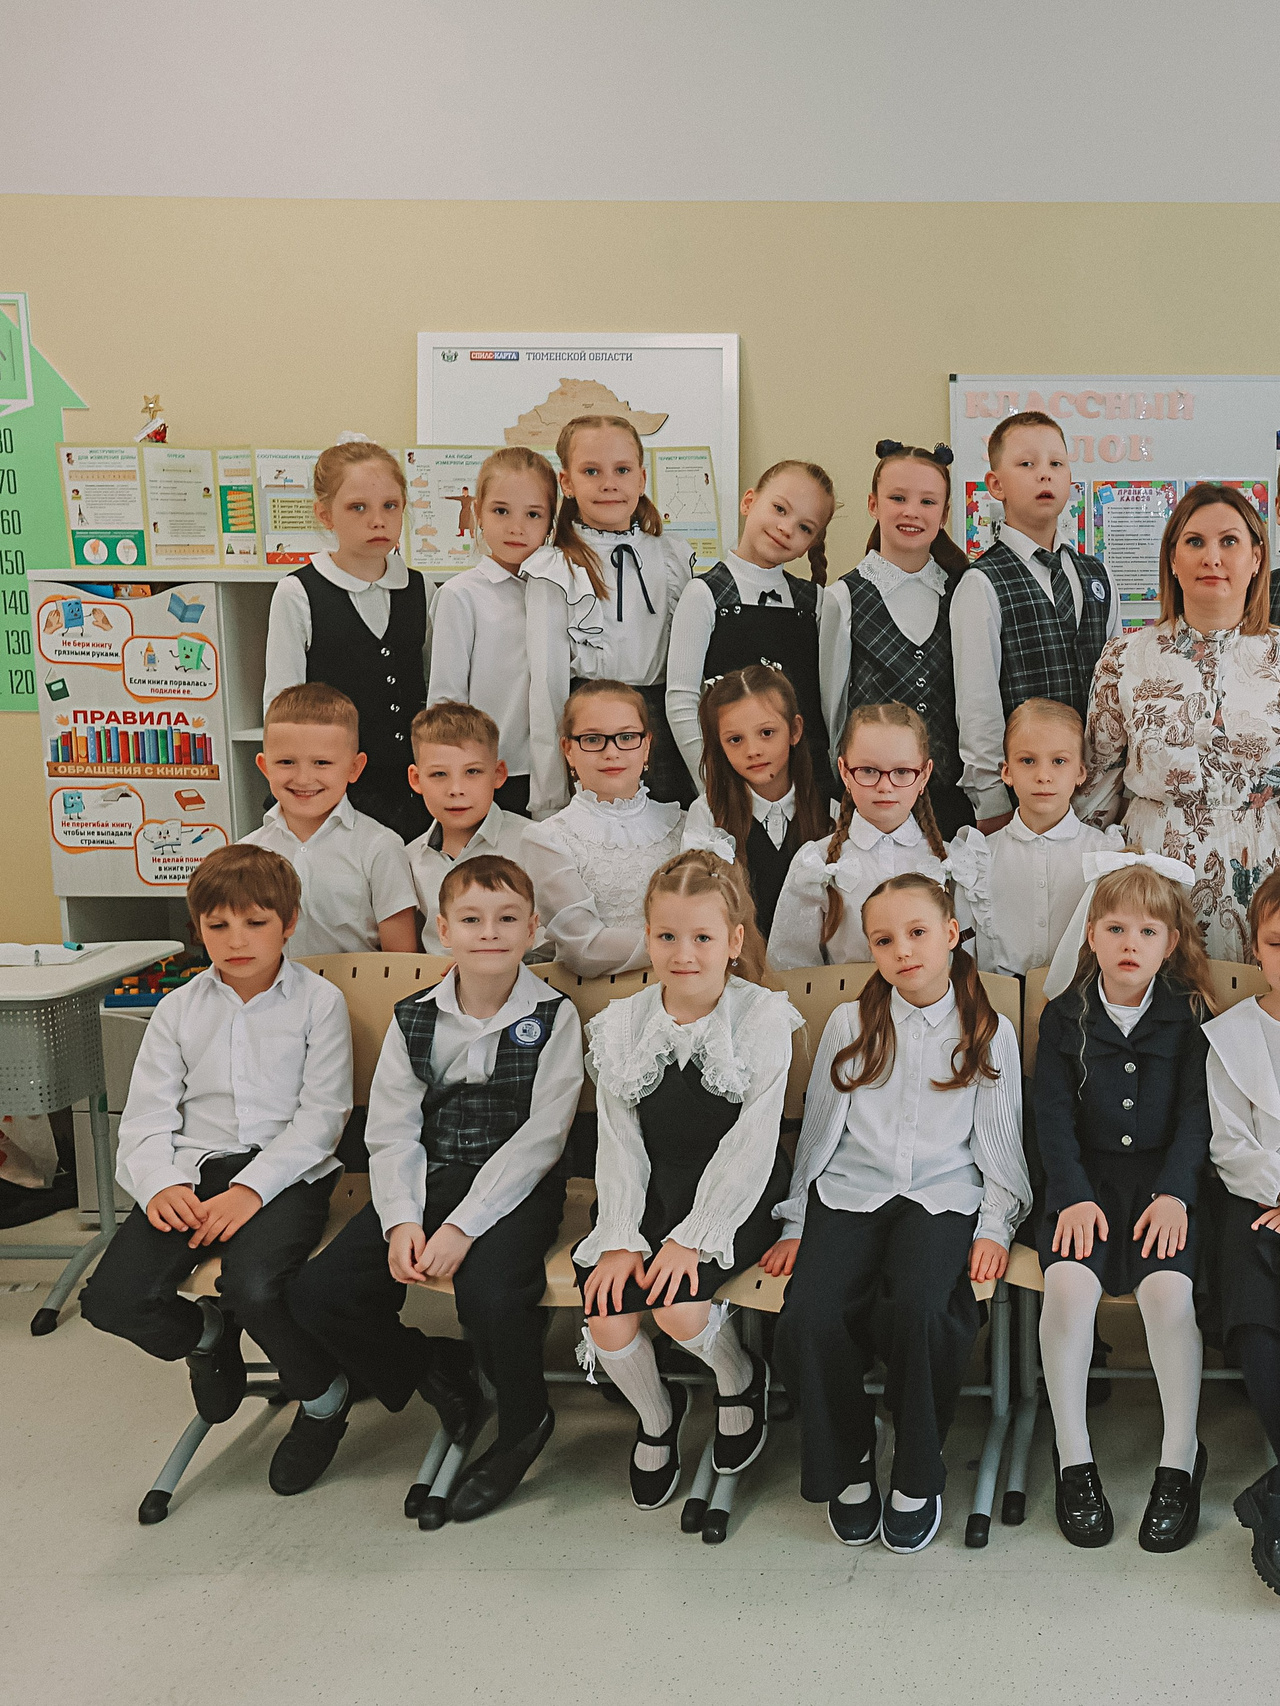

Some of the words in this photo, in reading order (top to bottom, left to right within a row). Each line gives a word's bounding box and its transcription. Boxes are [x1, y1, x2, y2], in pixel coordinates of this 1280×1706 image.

[526, 351, 586, 361] ТЮМЕНСКОЙ
[588, 352, 633, 361] ОБЛАСТИ
[0, 550, 26, 576] 150
[1, 590, 30, 616] 140
[5, 630, 32, 656] 130
[72, 640, 91, 649] бери
[91, 642, 113, 650] книгу
[54, 650, 91, 658] грязными
[91, 651, 121, 659] руками.
[8, 669, 36, 695] 120
[129, 677, 147, 685] Если
[168, 680, 208, 688] порвалась
[150, 686, 181, 695] подклей
[72, 710, 190, 726] ПРАВИЛА
[58, 765, 142, 776] ОБРАЩЕНИЯ
[144, 766, 154, 776] С
[156, 764, 210, 777] КНИГОЙ
[72, 820, 110, 829] перегибай
[63, 829, 86, 837] чтобы
[80, 837, 117, 845] страницы.
[162, 856, 184, 864] делай
